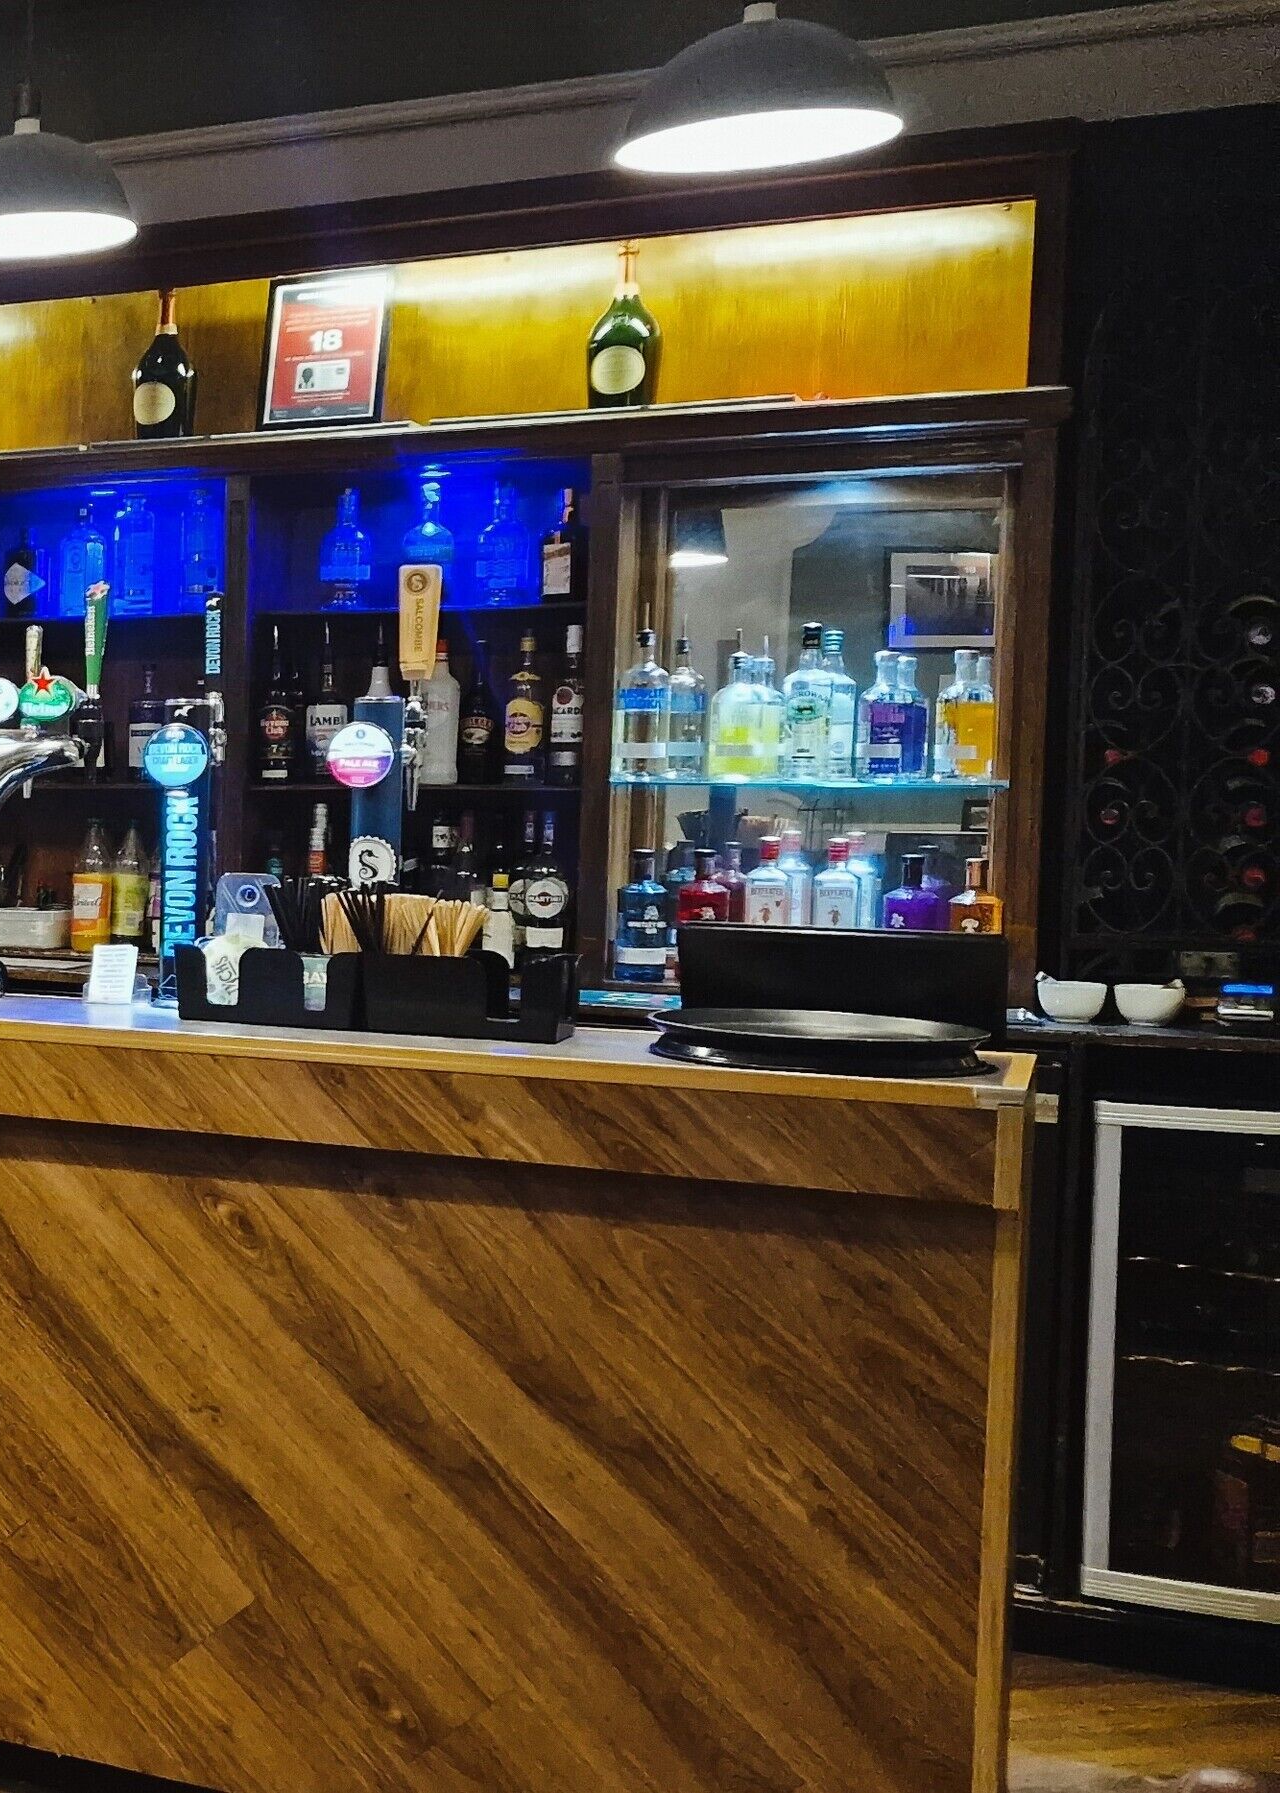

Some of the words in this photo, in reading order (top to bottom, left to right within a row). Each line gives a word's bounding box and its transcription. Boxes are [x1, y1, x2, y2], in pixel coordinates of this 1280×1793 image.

[309, 328, 343, 353] 18
[165, 796, 199, 866] ROCK
[162, 870, 197, 957] DEVON
